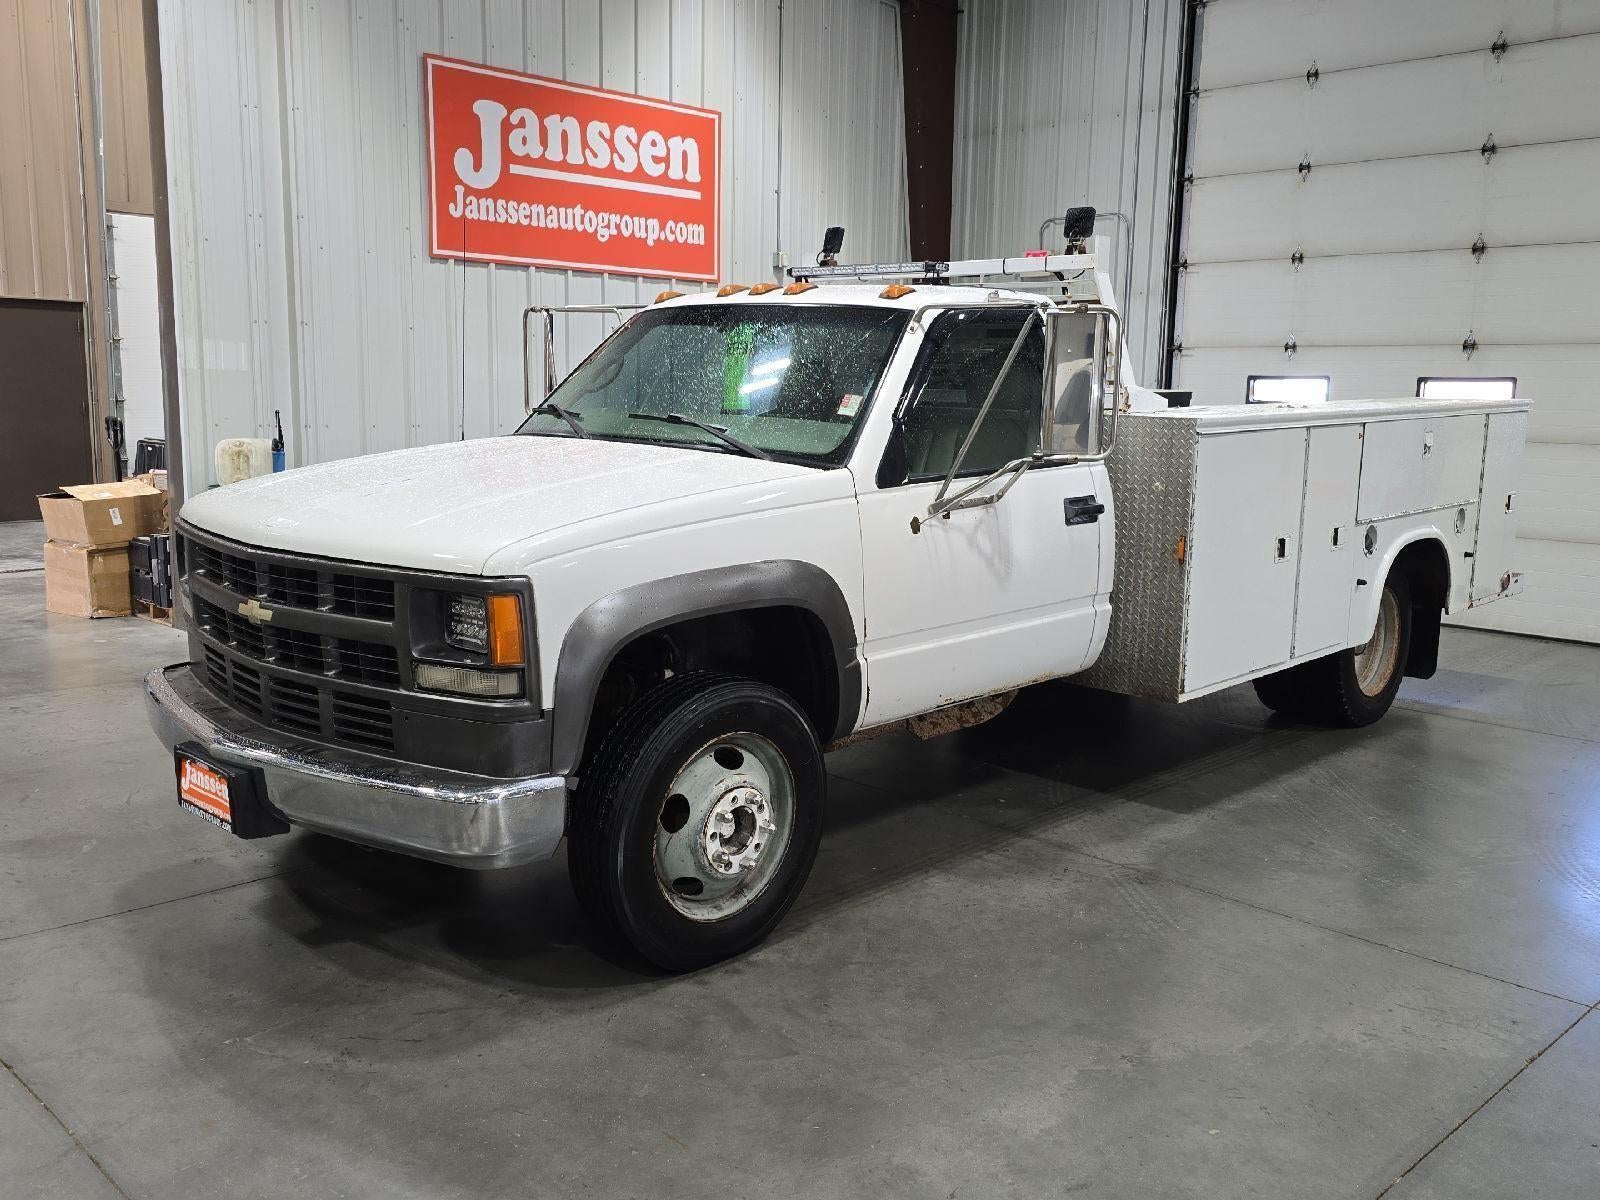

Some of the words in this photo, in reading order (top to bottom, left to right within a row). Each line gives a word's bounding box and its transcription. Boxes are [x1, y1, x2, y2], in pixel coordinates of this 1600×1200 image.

[453, 99, 702, 189] Janssen
[448, 184, 706, 247] Janssenautogroup.com
[181, 759, 229, 800] Janssen
